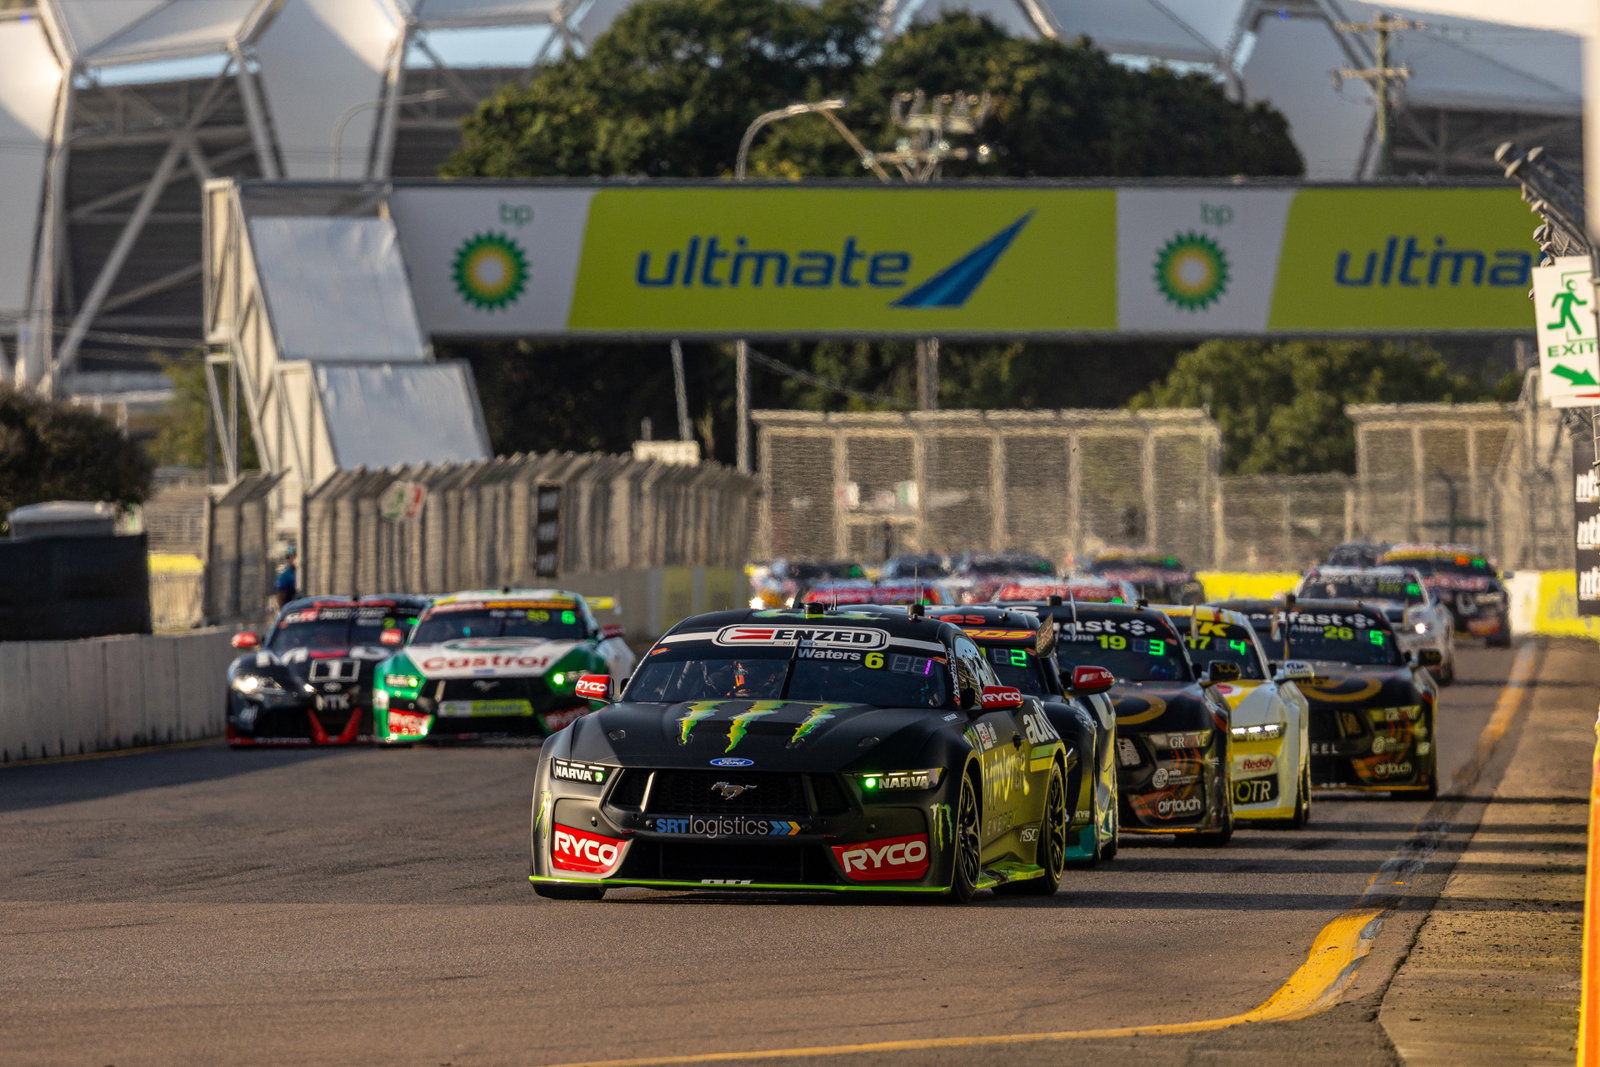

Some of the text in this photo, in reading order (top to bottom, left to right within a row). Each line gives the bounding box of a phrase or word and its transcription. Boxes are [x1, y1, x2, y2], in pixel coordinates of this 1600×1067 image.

[499, 201, 533, 226] bp
[1202, 202, 1234, 227] bp
[635, 235, 912, 288] ultimate
[1334, 235, 1546, 288] ultima
[1547, 343, 1596, 358] EXIT
[774, 629, 872, 643] ENZED
[1324, 625, 1354, 640] 26
[1369, 630, 1384, 646] 5
[1096, 635, 1127, 649] 19
[1149, 639, 1165, 656] 3
[1229, 639, 1246, 656] 4
[422, 656, 549, 671] Castrol
[798, 649, 884, 669] Waters 6
[1011, 649, 1027, 667] 2
[576, 679, 607, 692] RYCO
[982, 692, 1022, 703] RYCO
[719, 757, 746, 767] Ford
[1243, 759, 1274, 771] Reddy
[1375, 761, 1412, 775] airtouch
[556, 765, 593, 781] NARVA
[878, 775, 929, 789] NARVA
[1236, 780, 1271, 801] OTR
[1158, 796, 1201, 813] airtouch
[554, 830, 619, 866] RYCO
[842, 840, 927, 873] RYCO
